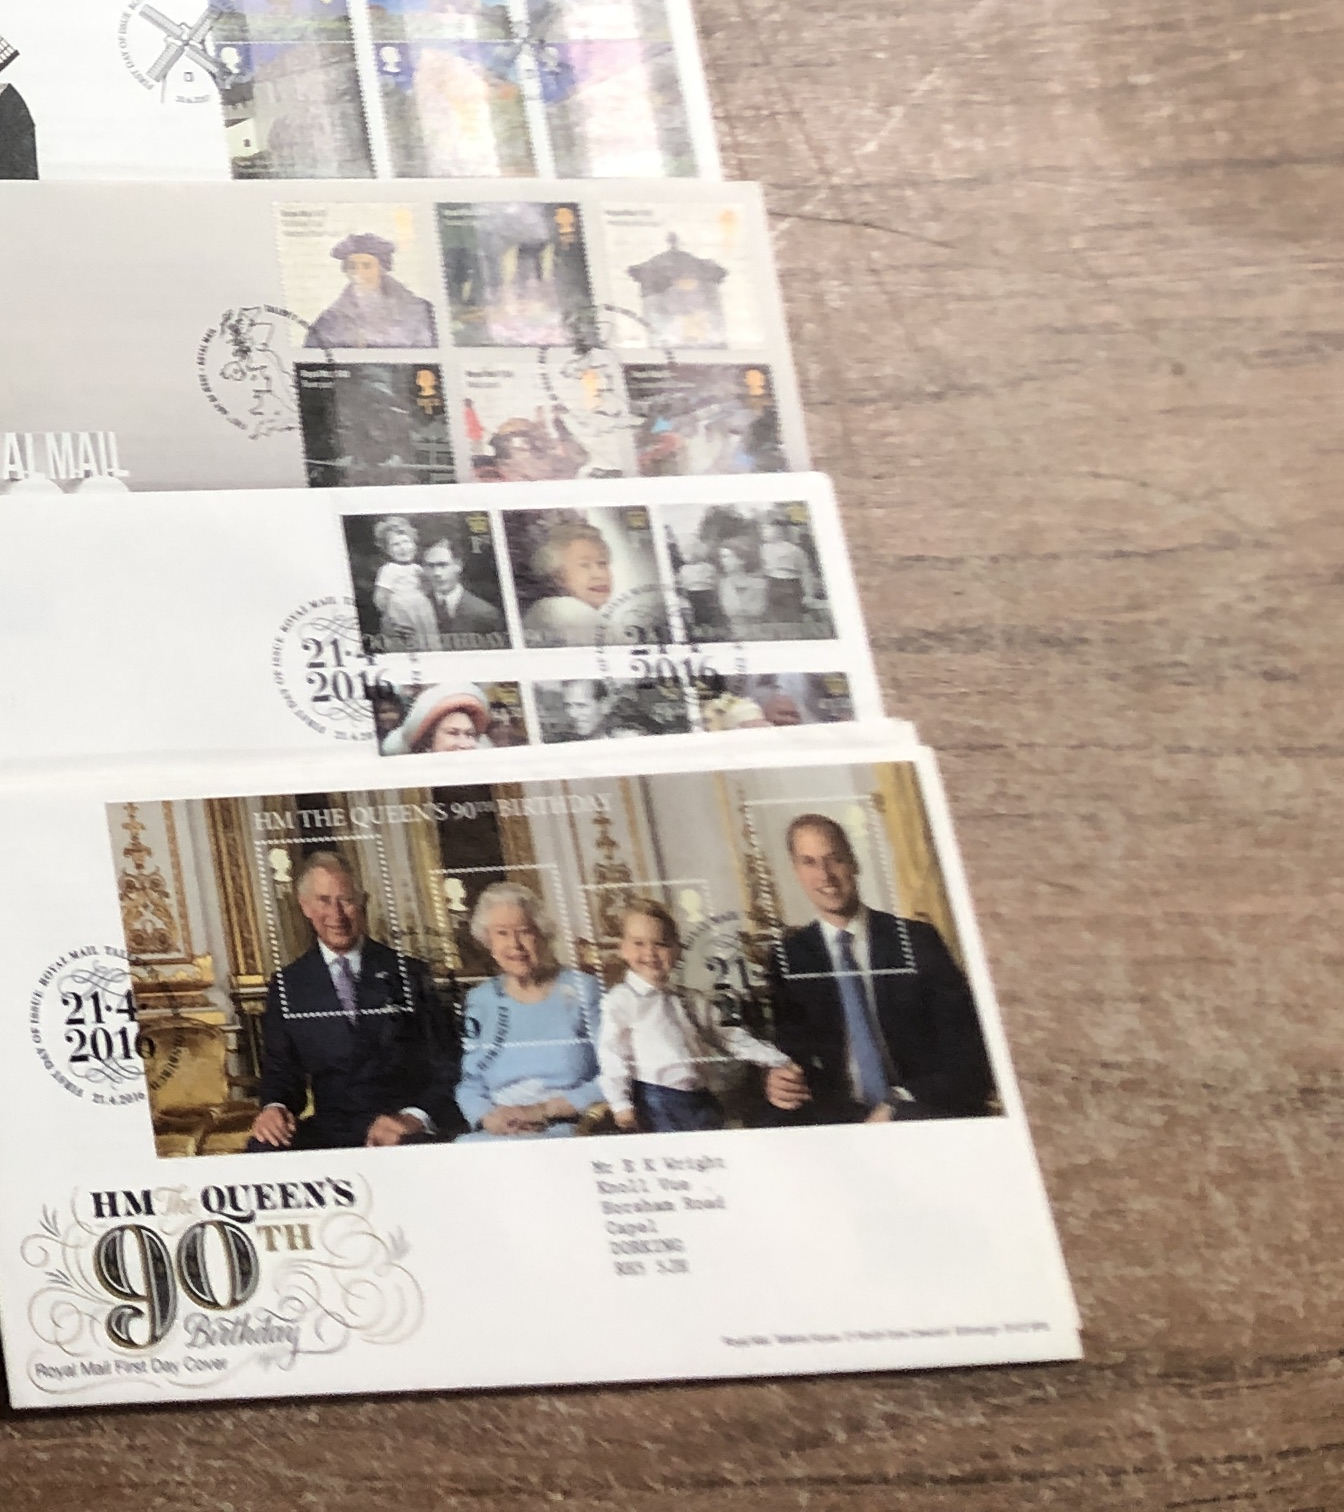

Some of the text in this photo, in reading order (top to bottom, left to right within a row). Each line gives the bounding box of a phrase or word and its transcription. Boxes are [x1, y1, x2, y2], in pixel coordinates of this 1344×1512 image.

[45, 431, 131, 480] MAIL
[253, 792, 614, 831] HM THE QUEEN'S BIRTHDAY
[64, 1025, 157, 1063] 2016
[90, 1176, 358, 1224] HM QUEEN'S
[34, 1356, 229, 1379] Royal Mail First Day Cover
